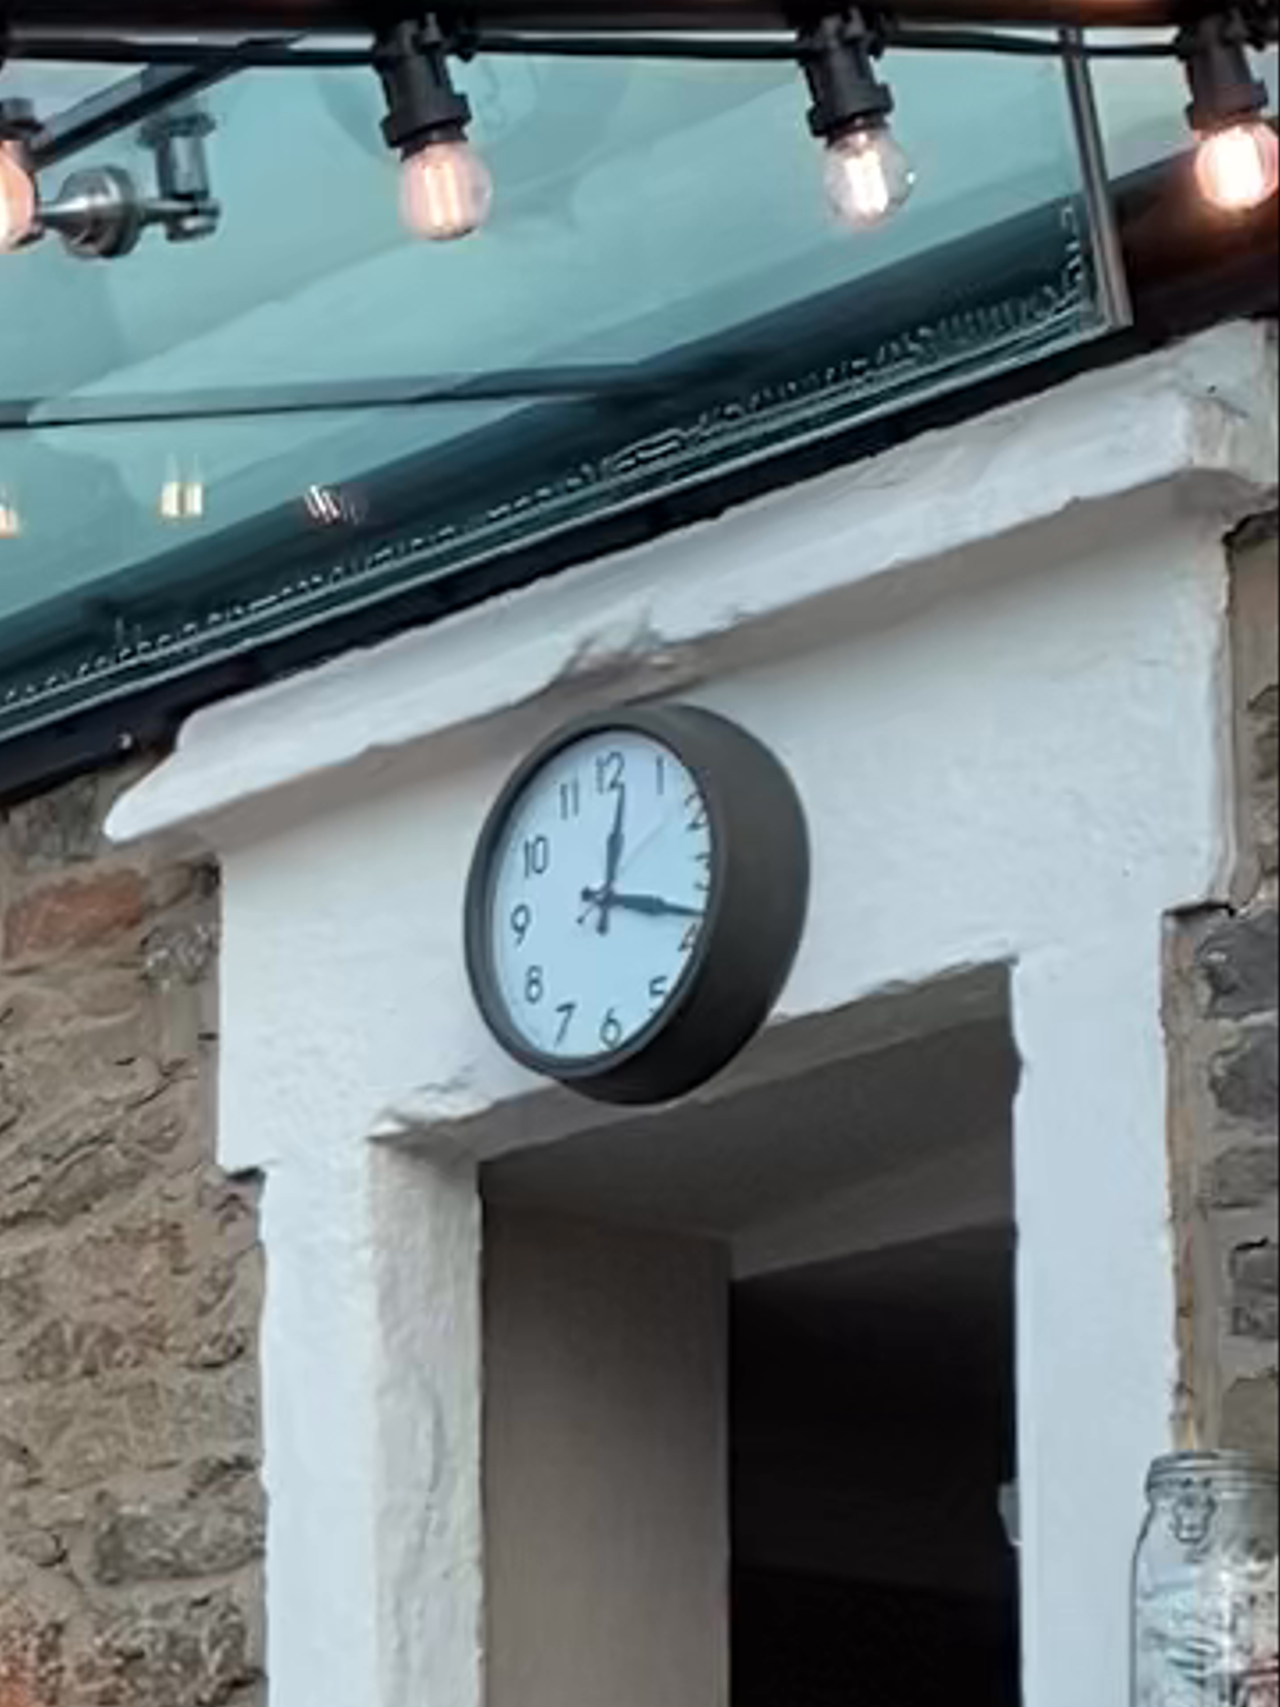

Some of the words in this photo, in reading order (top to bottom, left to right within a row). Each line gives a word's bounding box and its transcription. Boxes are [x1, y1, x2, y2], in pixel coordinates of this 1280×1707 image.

[595, 750, 626, 794] 12
[656, 755, 665, 795] 1
[559, 775, 580, 820] 11
[684, 789, 708, 831] 2
[524, 834, 549, 878] 10
[510, 903, 532, 945] 9
[524, 965, 544, 1005] 8
[555, 1003, 578, 1047] 7
[600, 1008, 623, 1049] 6
